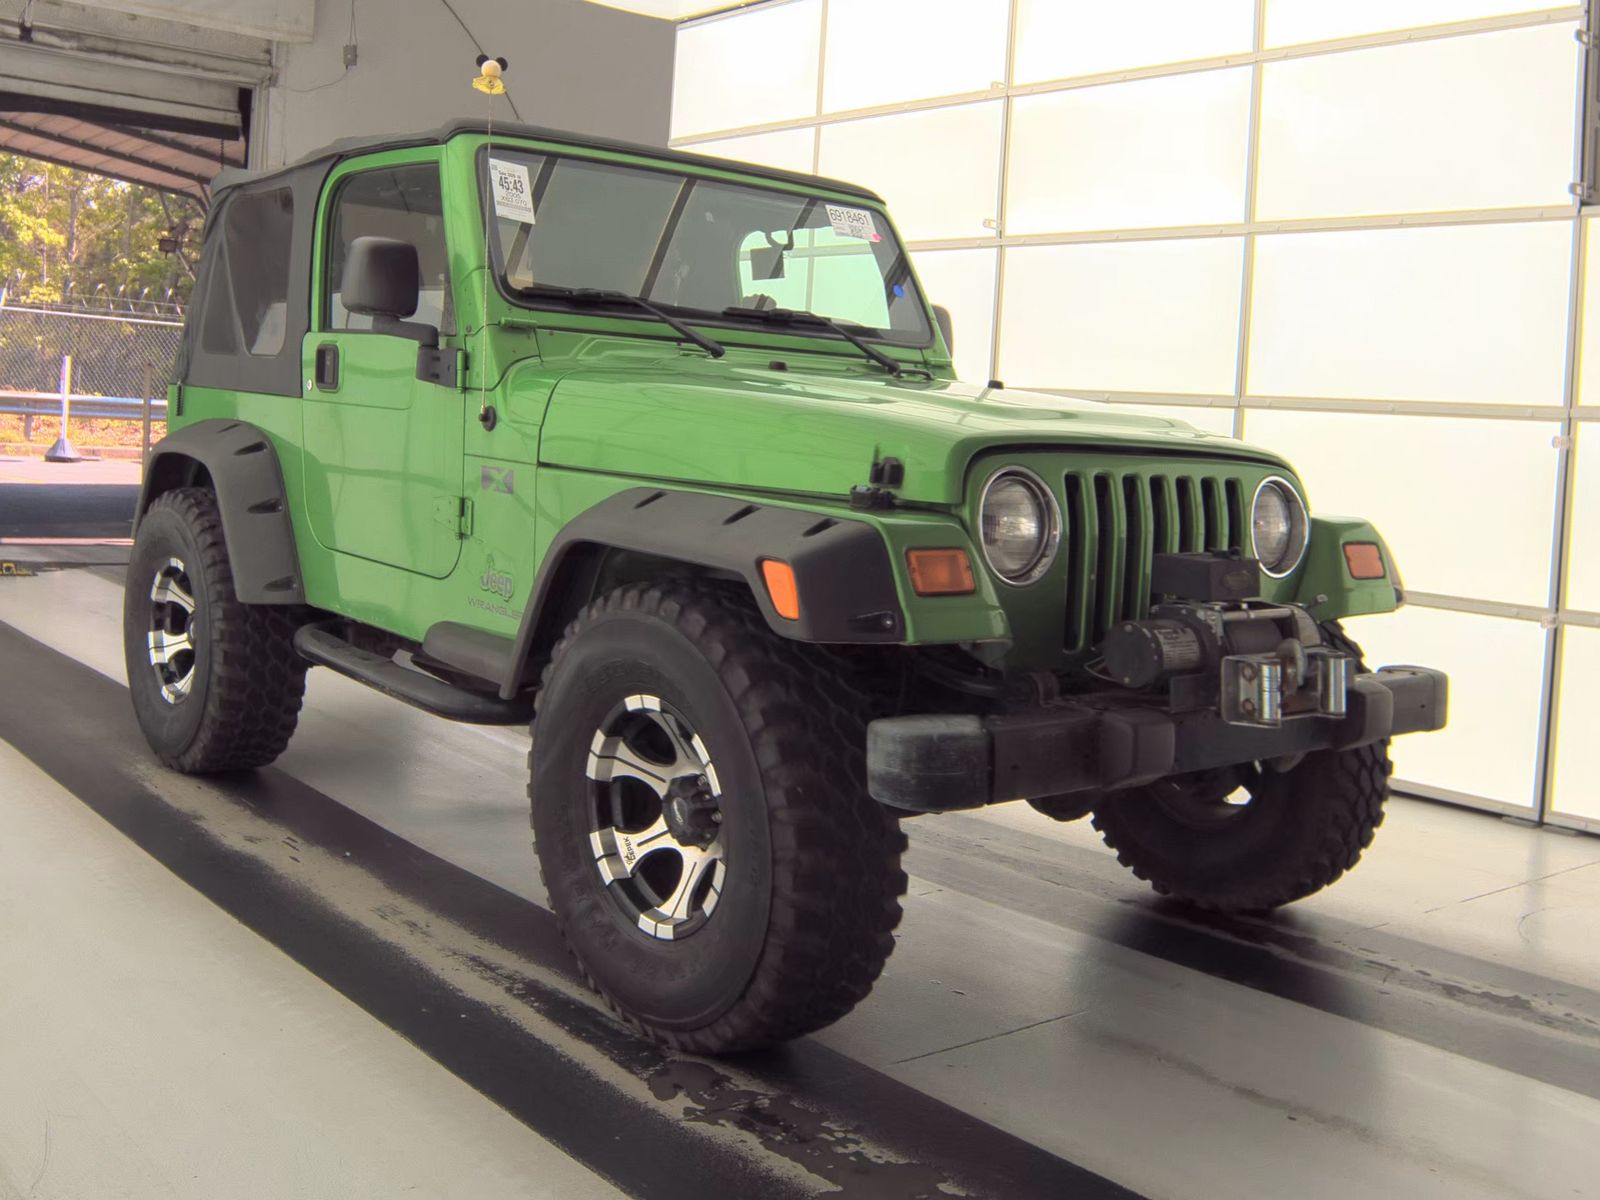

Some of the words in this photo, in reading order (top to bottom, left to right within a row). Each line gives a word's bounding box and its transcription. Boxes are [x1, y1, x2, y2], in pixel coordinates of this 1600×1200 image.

[499, 175, 524, 194] 45:43
[829, 208, 870, 226] 6918461
[480, 570, 514, 602] Jeep
[466, 595, 524, 620] WRANGLE
